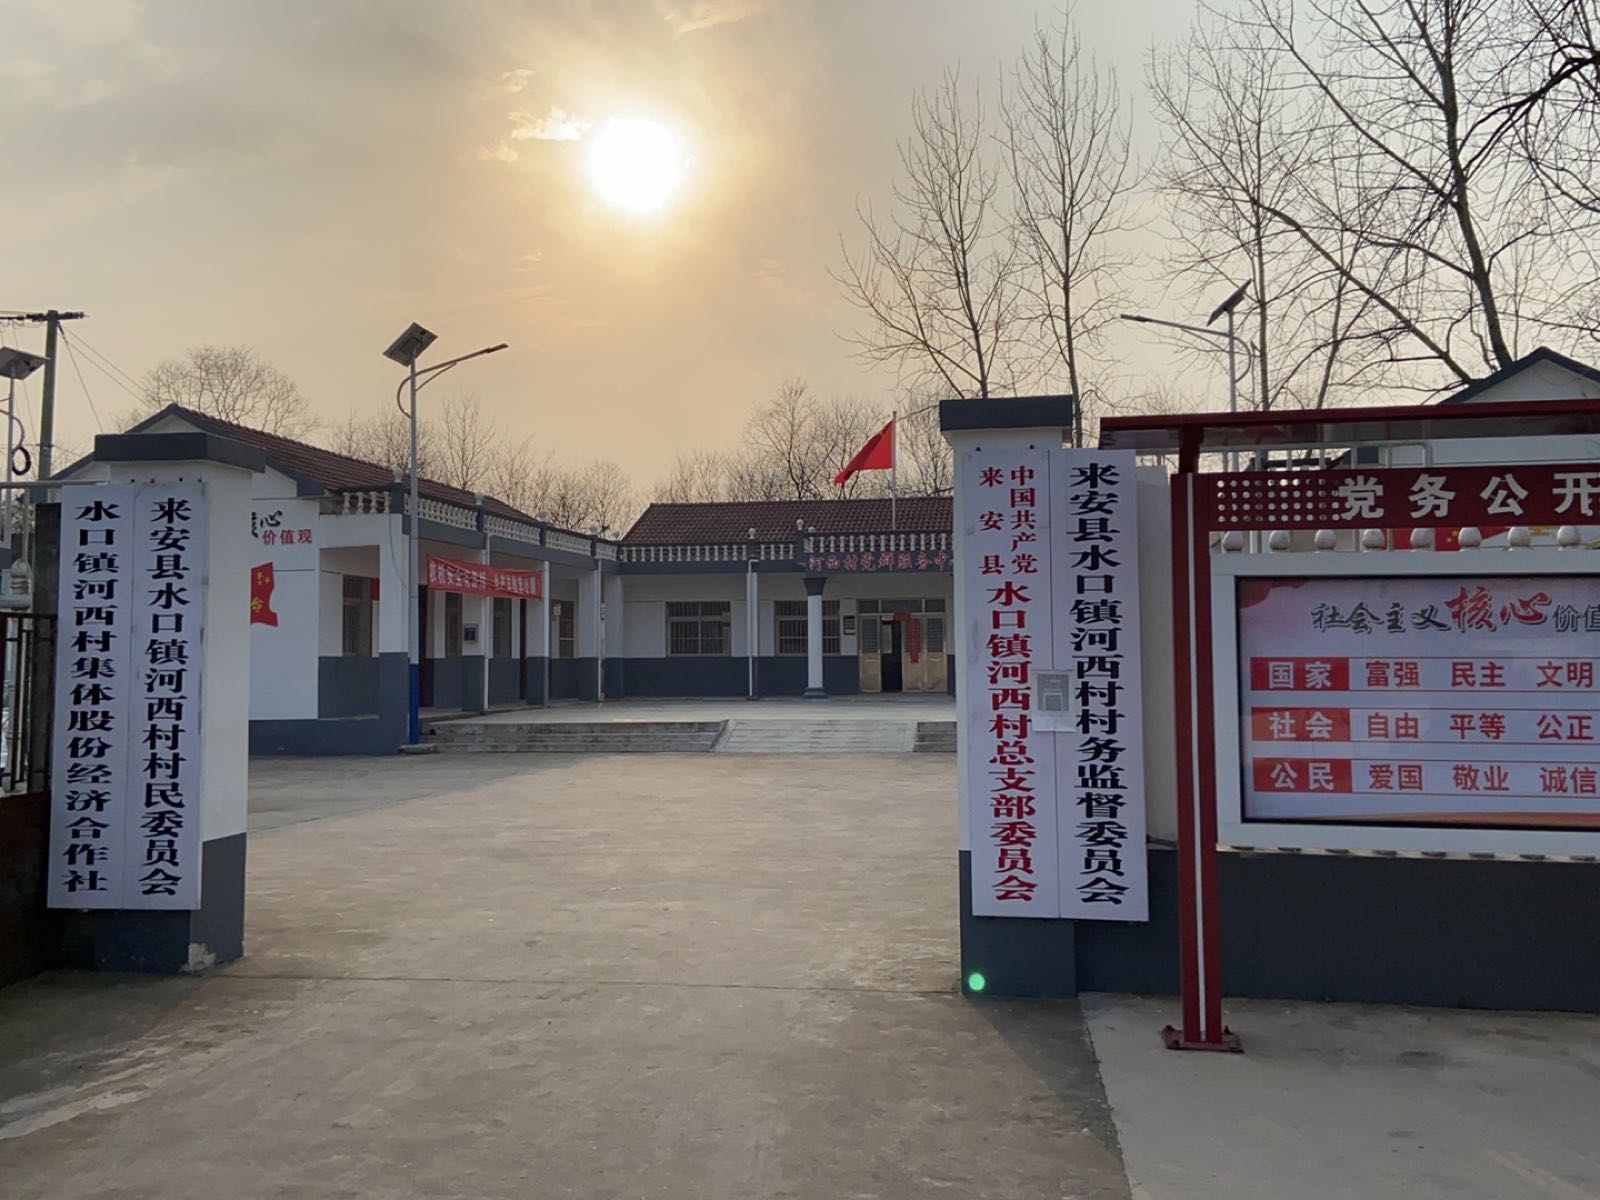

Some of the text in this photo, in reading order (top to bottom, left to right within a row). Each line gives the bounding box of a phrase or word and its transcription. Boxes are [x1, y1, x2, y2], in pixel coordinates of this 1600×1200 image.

[978, 466, 1005, 575] 来安县
[1010, 466, 1038, 575] 中国共产党
[1338, 472, 1599, 520] 党务公开
[262, 529, 312, 545] 价值观
[809, 549, 953, 572] 河西村党群服务中
[61, 500, 121, 893] 水口镇河西村集体股份经济合作社
[138, 497, 192, 896] 来安县水口镇河西村村民委员会
[1066, 463, 1129, 905] 来安县水口镇河西村村务监督委员会
[1268, 661, 1593, 688] 国家 富强 民主 文明
[986, 580, 1039, 902] 水口镇河西村总支部委员会
[1268, 713, 1593, 741] 社会 自由 平等 公正
[1270, 763, 1597, 794] 公民 爱国 敬业 诚信
